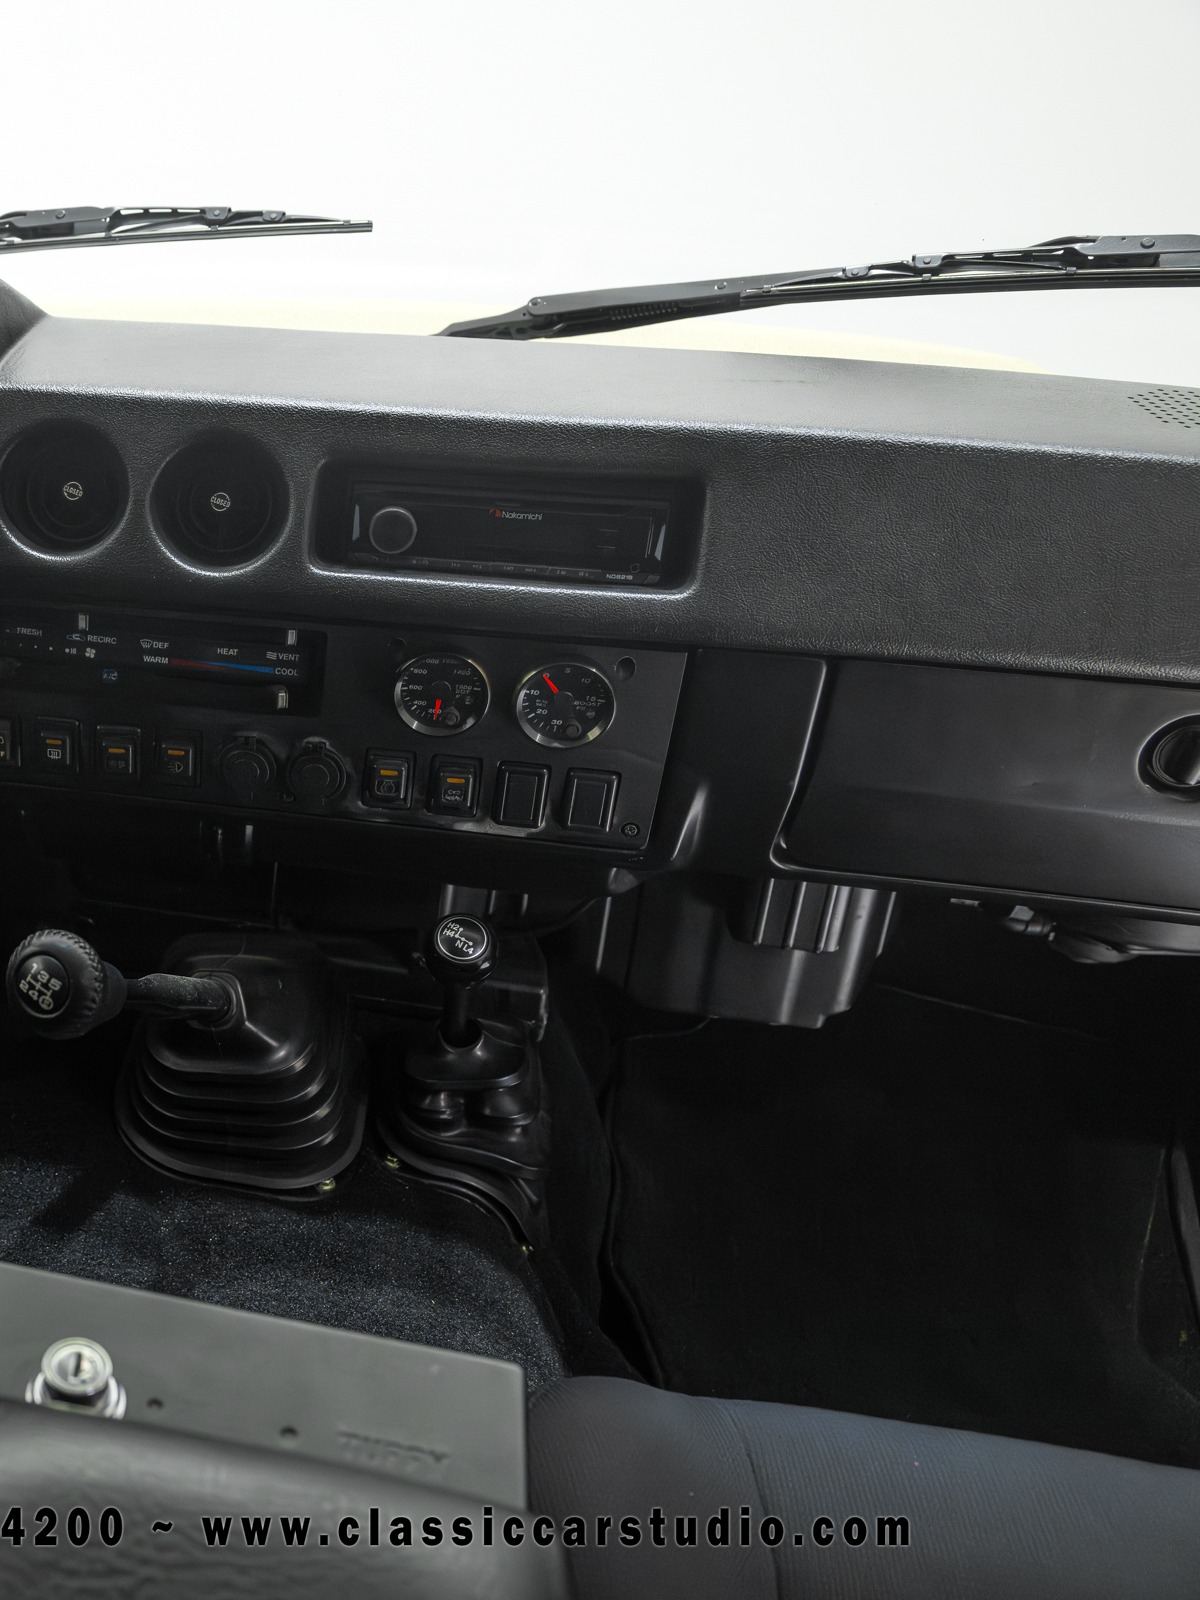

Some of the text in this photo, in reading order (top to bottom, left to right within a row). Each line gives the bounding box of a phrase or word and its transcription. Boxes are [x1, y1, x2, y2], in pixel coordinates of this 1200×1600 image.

[63, 485, 83, 497] CLOSED
[210, 496, 231, 508] CLOSED
[502, 510, 542, 520] Nakamichi
[17, 627, 42, 637] FRESH
[87, 634, 117, 645] RECIRC
[153, 641, 169, 650] DEF
[217, 647, 238, 656] HEAT
[143, 654, 169, 665] WARM
[278, 652, 300, 662] VENT
[275, 667, 298, 677] COOL
[573, 700, 602, 708] BOOST
[446, 922, 460, 931] H2
[442, 928, 456, 938] H4
[454, 939, 474, 955] N L4
[30, 962, 63, 991] 1 3 5
[19, 979, 30, 993] 2
[28, 989, 39, 1001] 4
